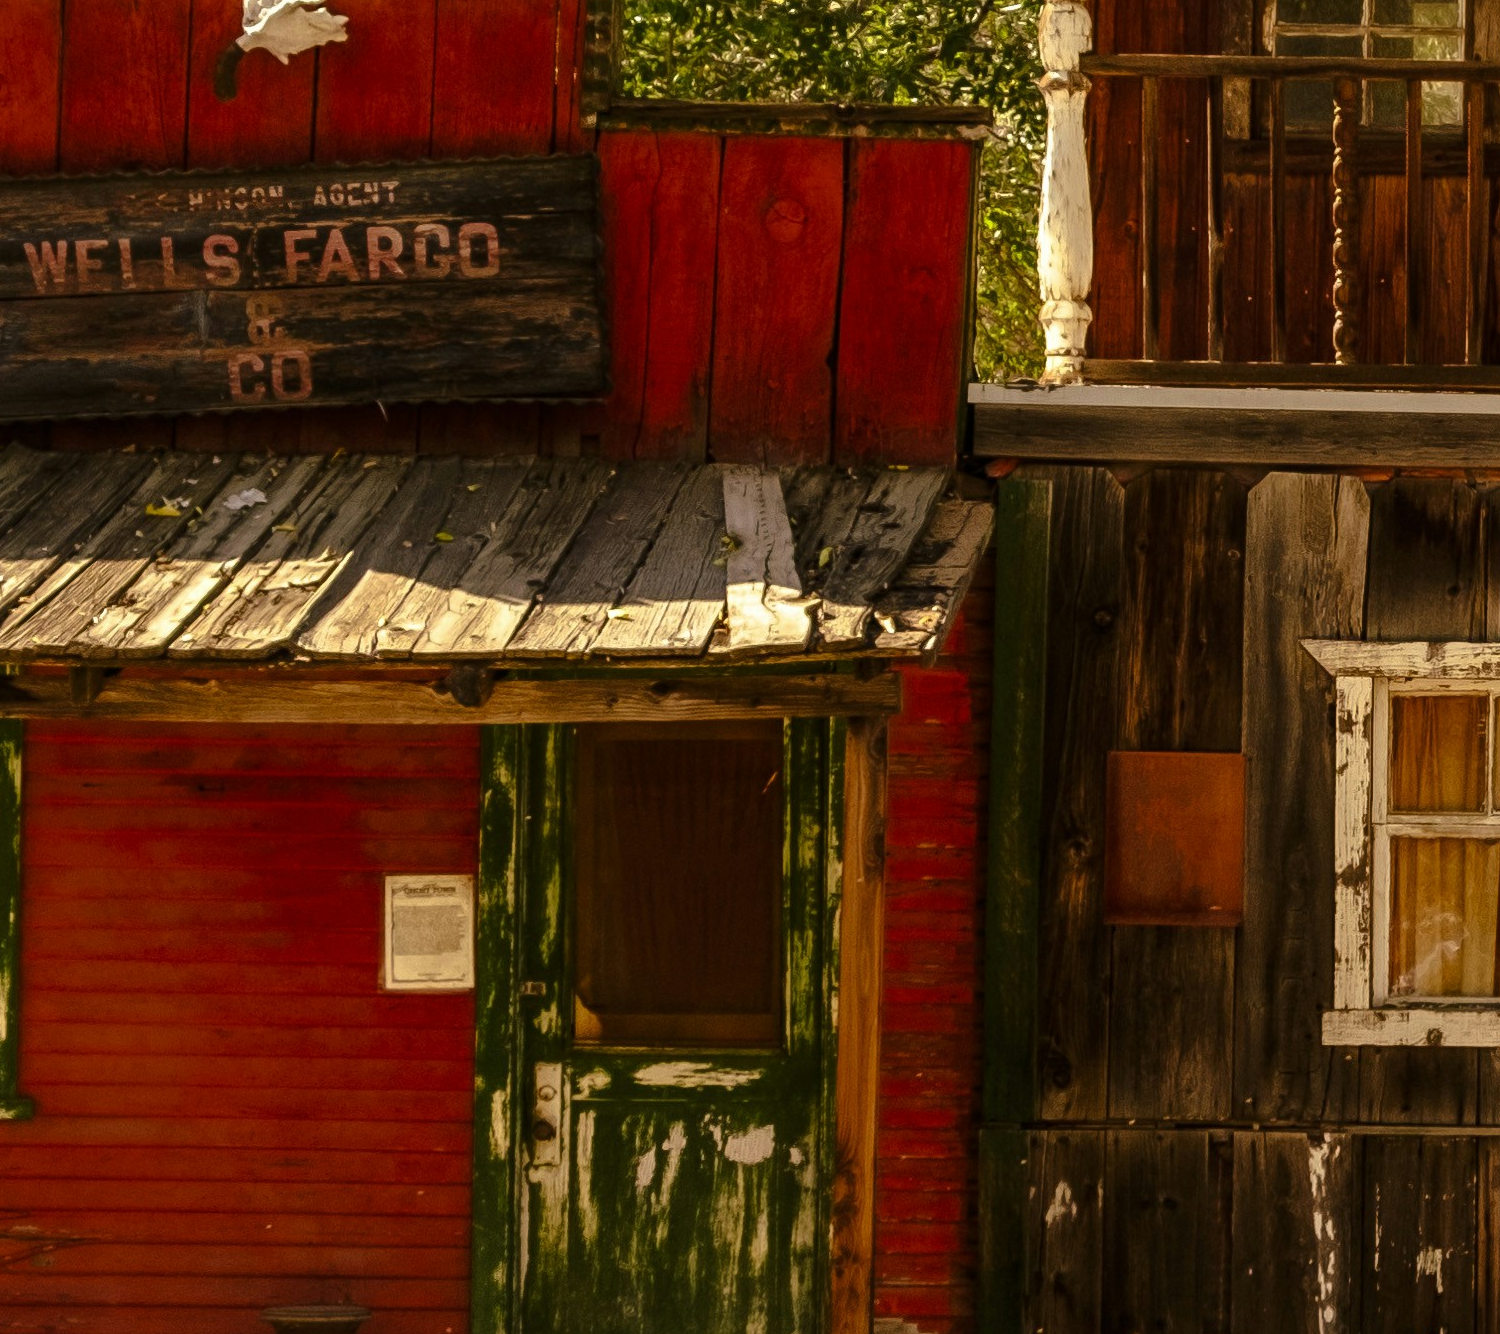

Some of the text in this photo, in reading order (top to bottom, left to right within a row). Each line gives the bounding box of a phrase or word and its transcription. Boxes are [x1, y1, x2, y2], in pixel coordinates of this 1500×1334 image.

[313, 181, 400, 202] AGENT
[23, 223, 501, 294] WELLS FARGO
[245, 295, 286, 345] &
[228, 350, 313, 405] CO
